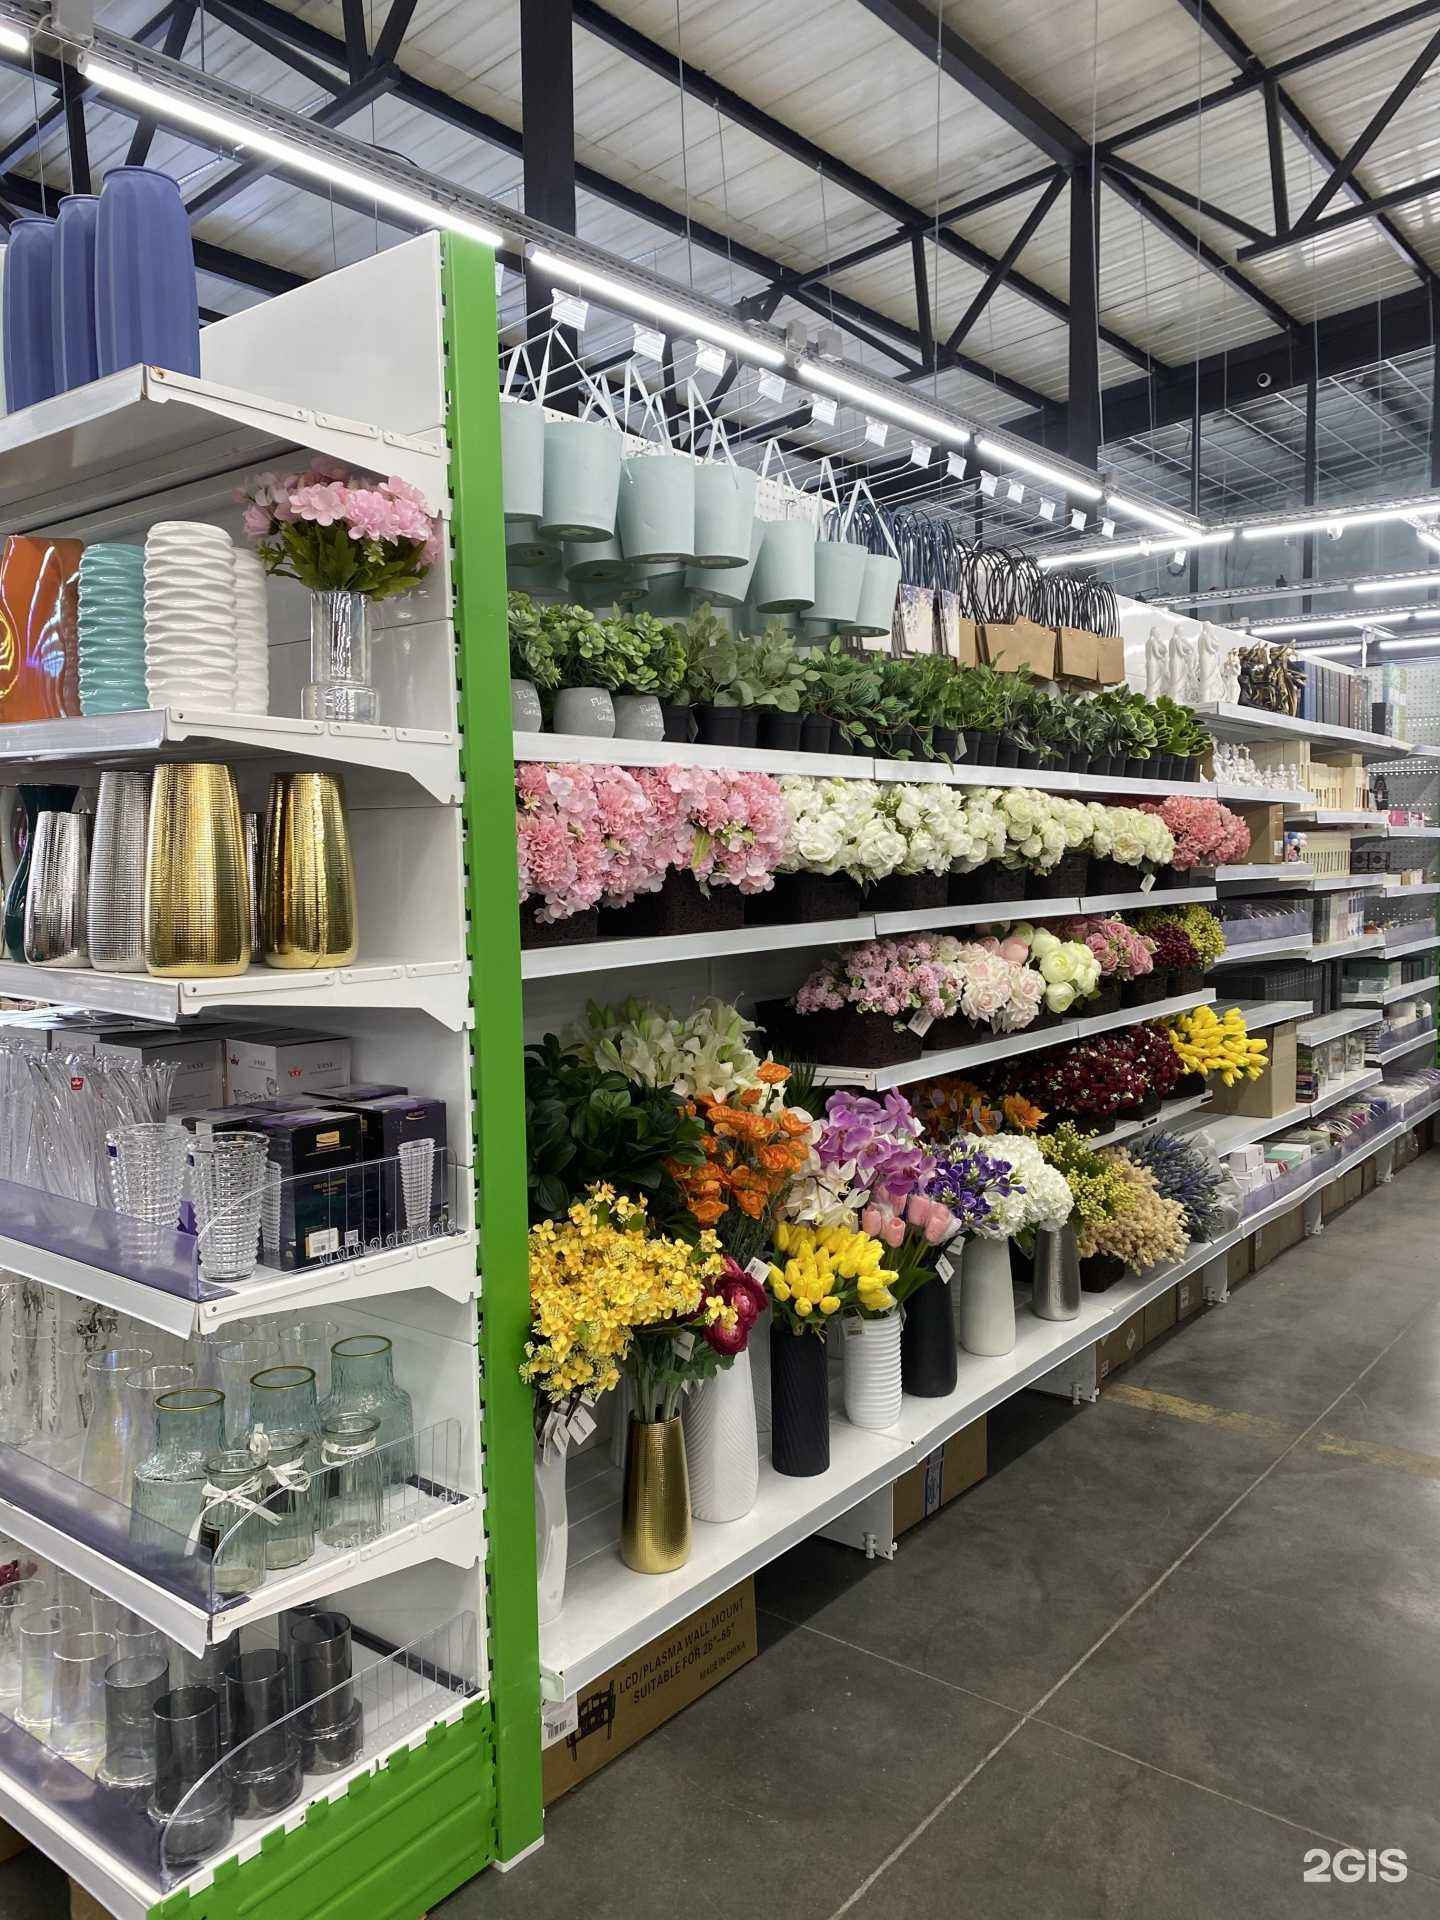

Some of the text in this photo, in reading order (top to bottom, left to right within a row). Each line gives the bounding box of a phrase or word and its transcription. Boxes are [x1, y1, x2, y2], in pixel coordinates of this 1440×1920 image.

[619, 1597, 744, 1694] LCD/PLASMA WALL MOUNT
[726, 1641, 747, 1662] CHINA
[633, 1663, 681, 1704] SUITABLE
[682, 1647, 701, 1669] FOR
